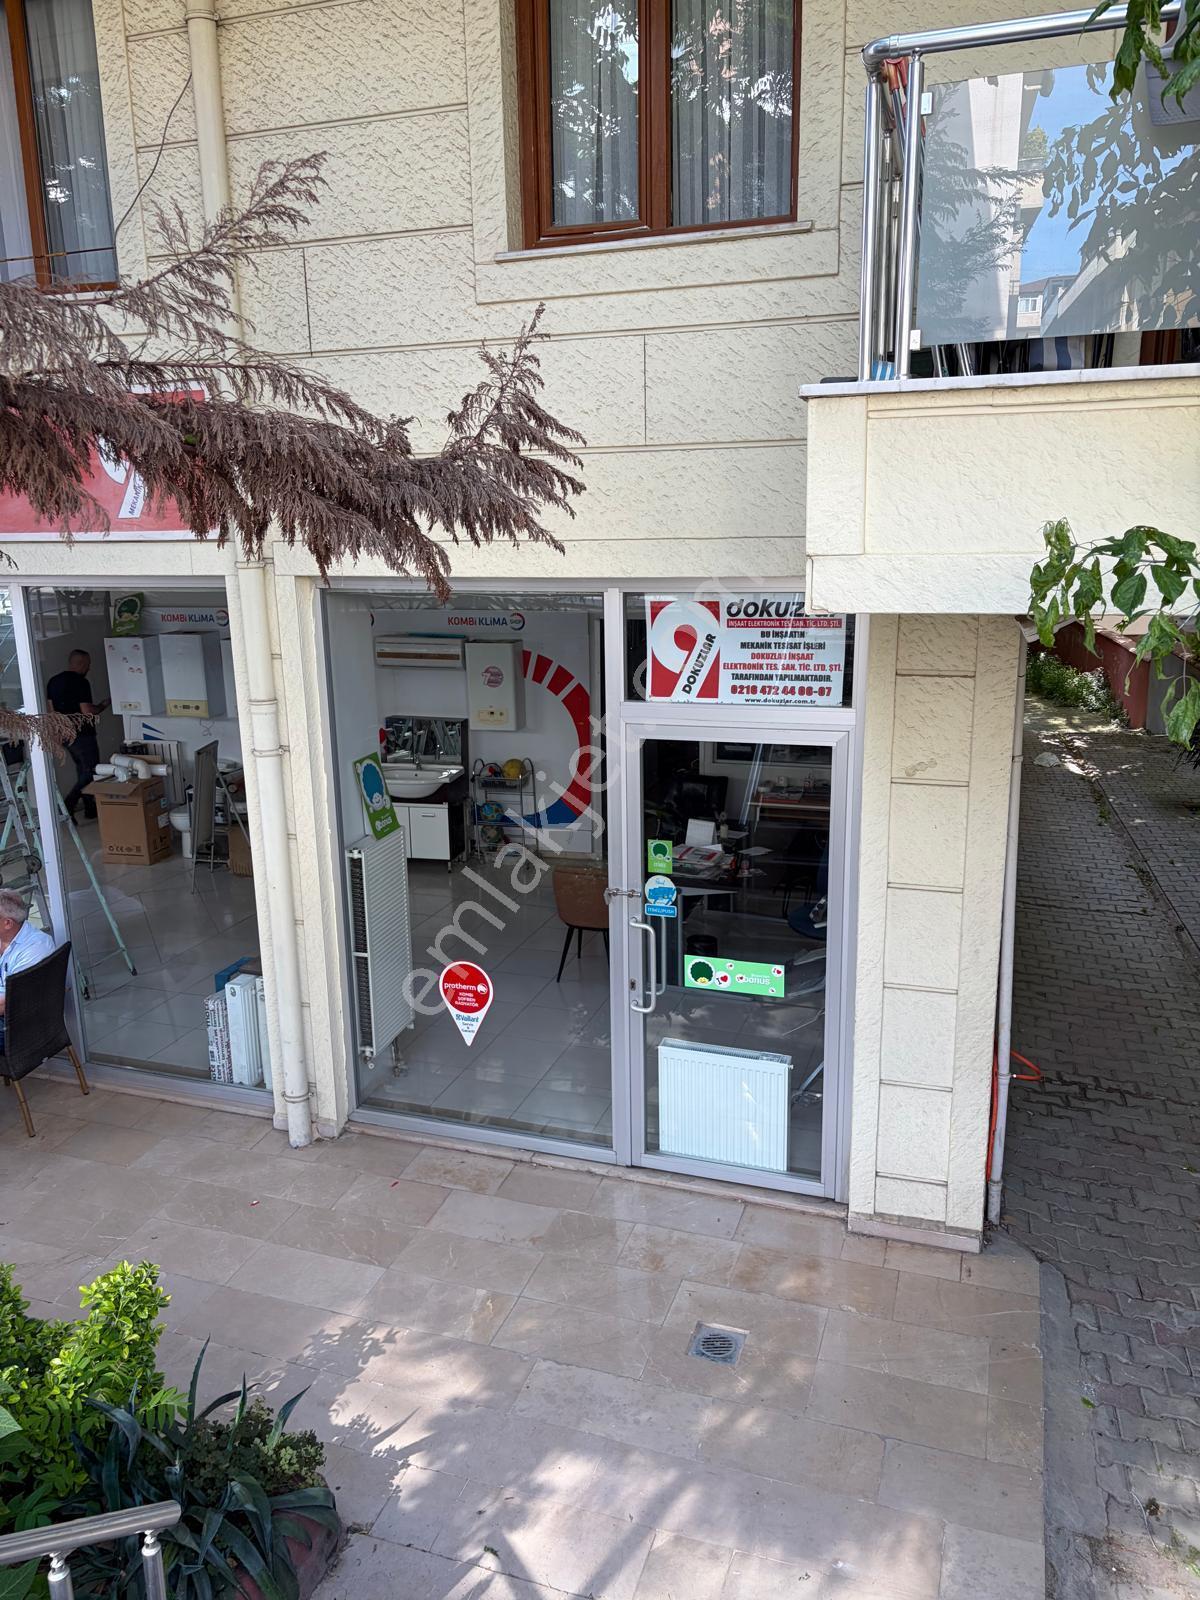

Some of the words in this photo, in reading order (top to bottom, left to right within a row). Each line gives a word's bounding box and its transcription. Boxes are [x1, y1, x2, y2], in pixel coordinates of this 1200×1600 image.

[740, 641, 771, 650] MEKANİK
[803, 641, 825, 651] İŞLERİ
[788, 652, 814, 661] İNŞAAT
[682, 633, 716, 694] DOKUZLAR
[723, 662, 764, 670] ELEKTRONİK
[798, 663, 812, 671] TİC.
[829, 663, 842, 672] ŞTİ.
[731, 673, 773, 681] TARAFINDAN
[775, 674, 833, 682] YAPILMAKTADIR.
[731, 684, 758, 694] 0216
[759, 685, 779, 695] 472
[781, 686, 796, 696] 44
[444, 982, 476, 990] protherm
